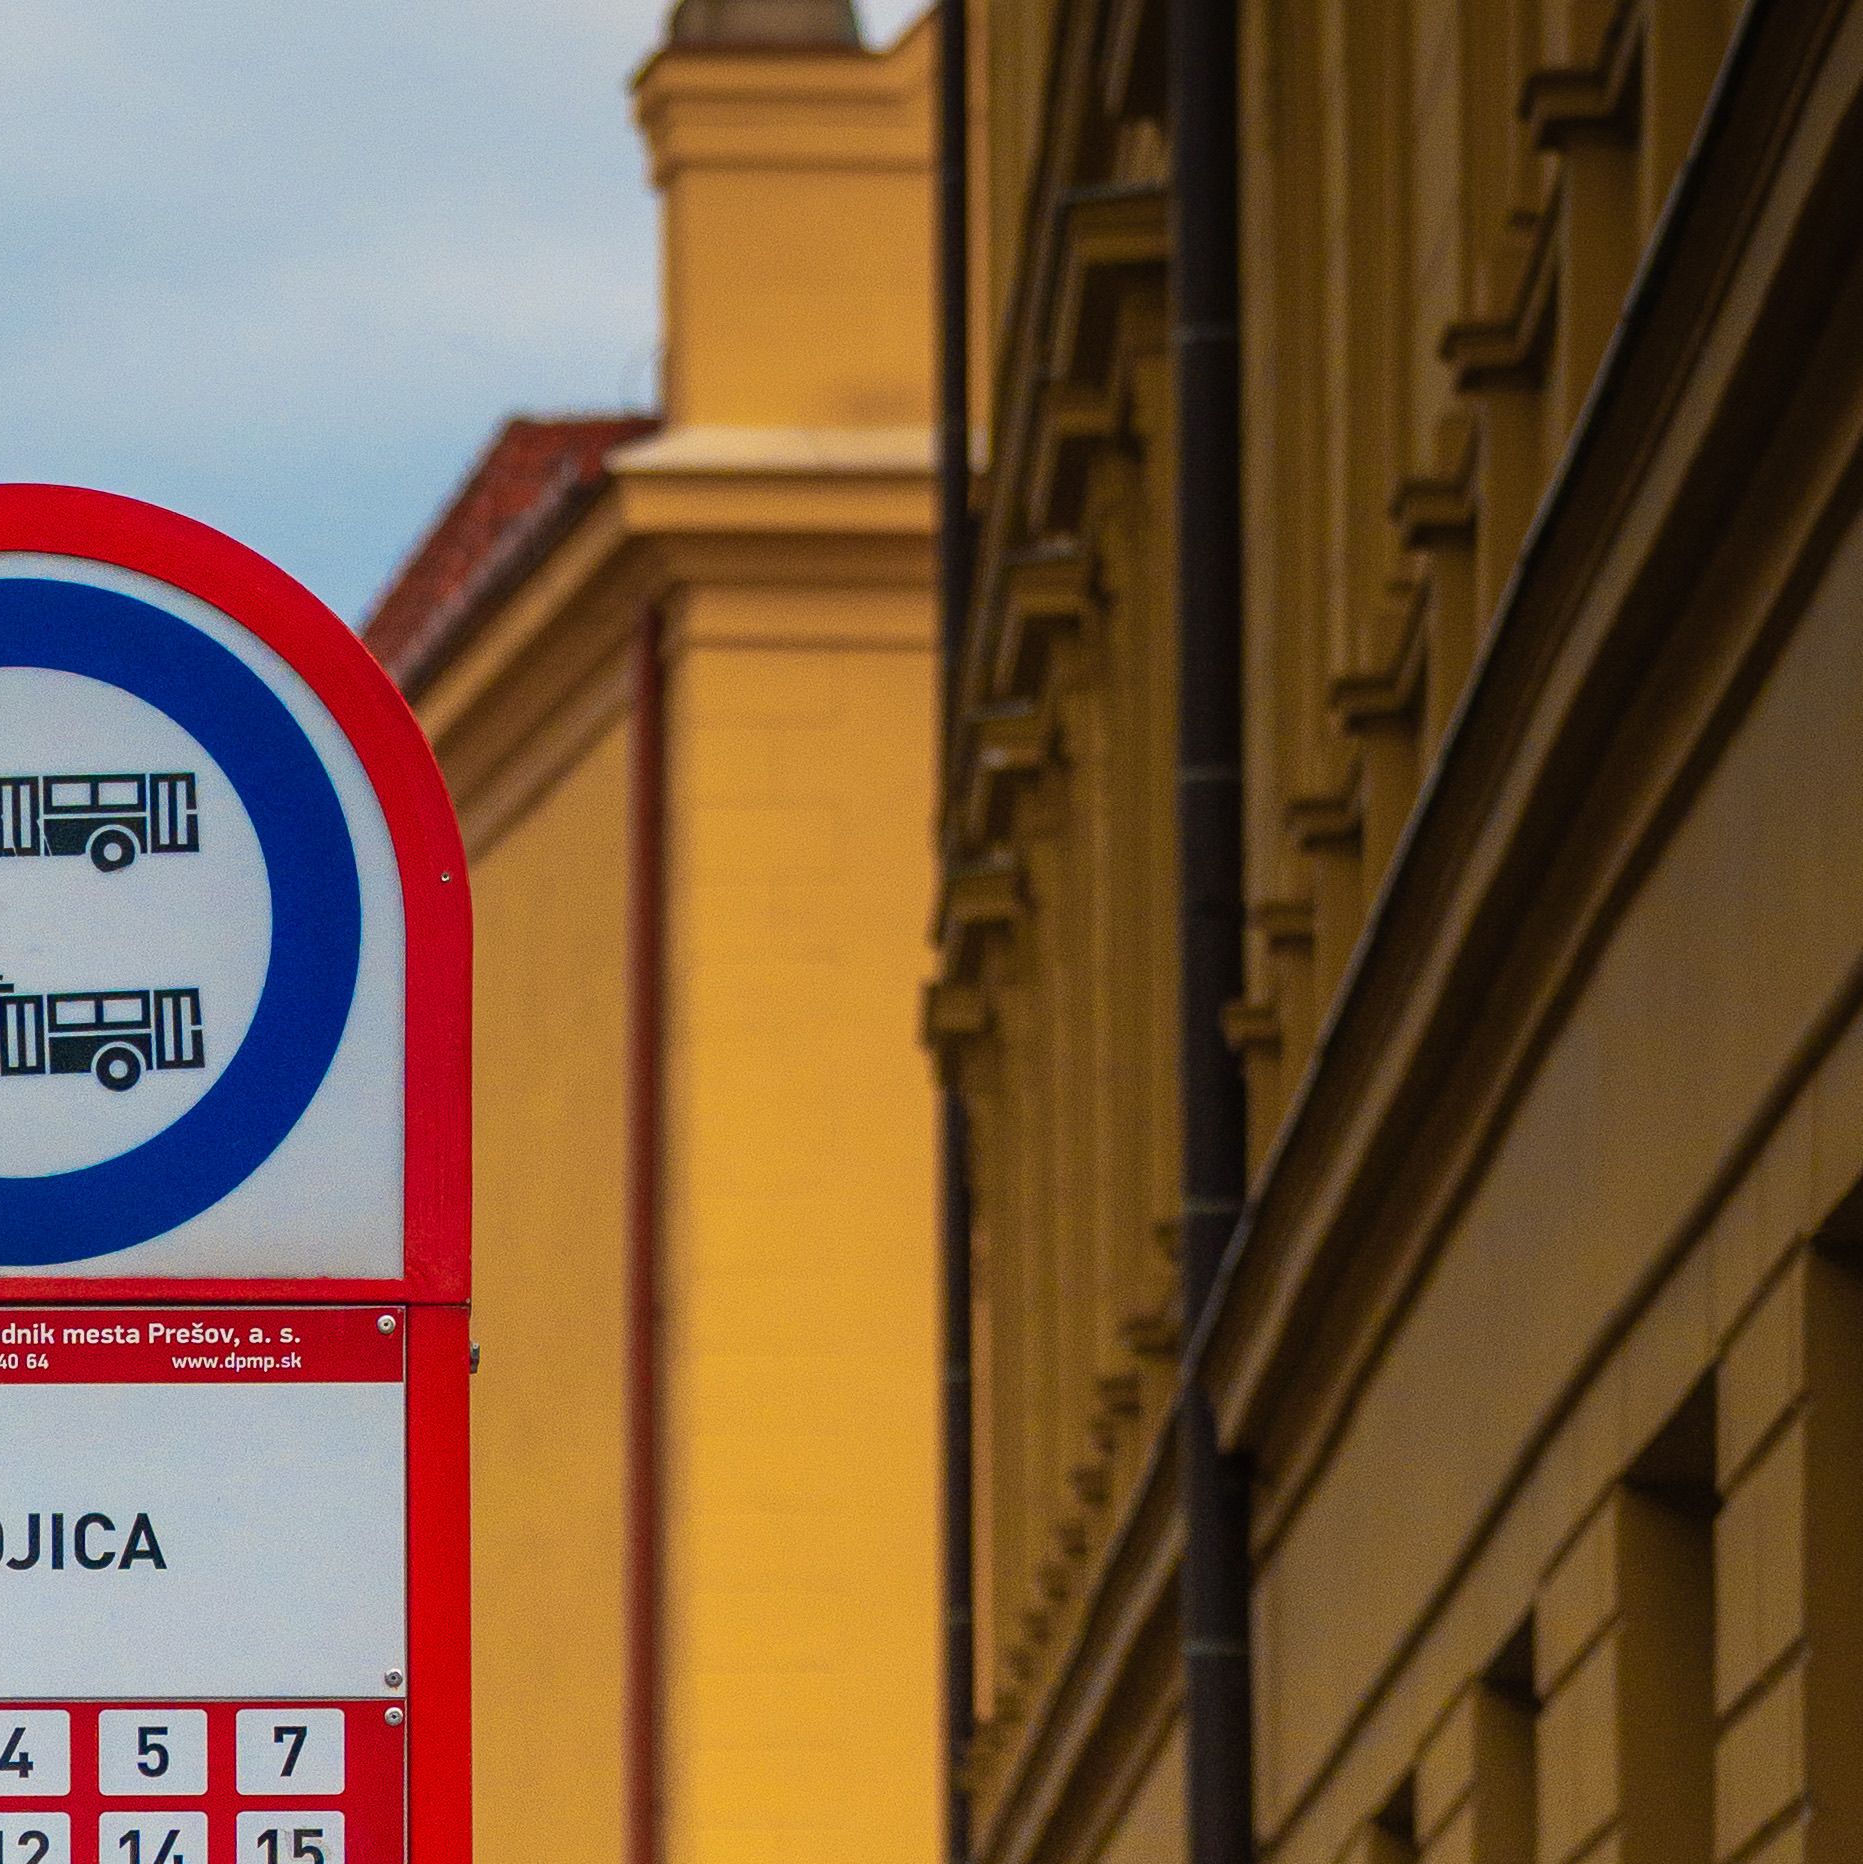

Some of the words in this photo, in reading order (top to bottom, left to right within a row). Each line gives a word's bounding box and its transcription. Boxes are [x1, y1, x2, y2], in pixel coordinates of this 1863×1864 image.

[63, 1327, 140, 1344] mesta
[149, 1322, 239, 1348] Prešov,
[249, 1330, 270, 1343] a.
[280, 1330, 300, 1343] s.
[26, 1354, 48, 1370] 64
[172, 1353, 301, 1372] www.dpmp.sk
[136, 1727, 169, 1778] 5
[273, 1727, 307, 1777] 7
